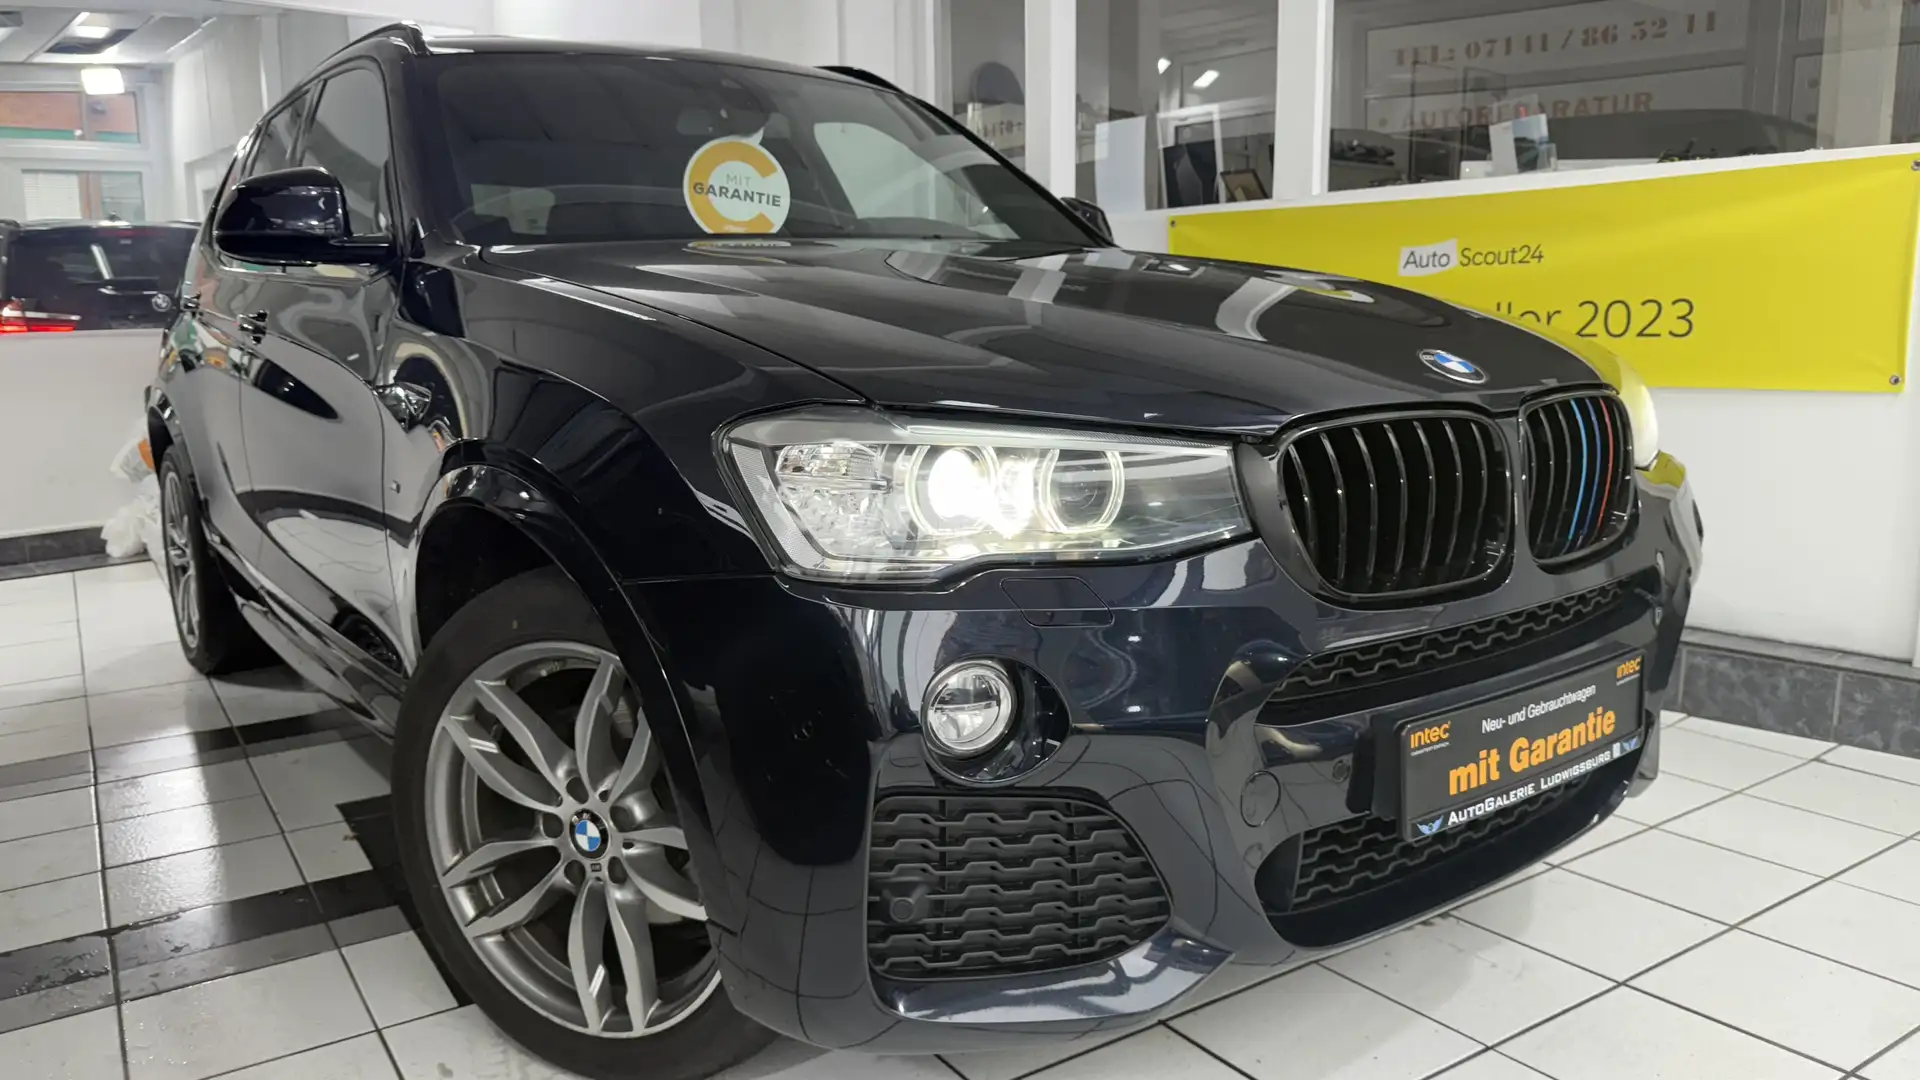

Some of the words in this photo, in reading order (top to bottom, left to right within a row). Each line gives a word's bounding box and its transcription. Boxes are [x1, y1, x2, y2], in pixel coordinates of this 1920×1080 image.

[1581, 24, 1618, 48] 86
[1631, 17, 1667, 41] 52
[725, 173, 752, 187] MIT
[693, 182, 781, 207] GARANTIE
[1403, 250, 1451, 269] Auto
[1459, 244, 1544, 267] Scout24
[1575, 298, 1695, 338] 2023
[1482, 718, 1506, 734] Neu-
[1508, 708, 1526, 726] und
[1527, 685, 1596, 719] Gebrauchtwagen
[1410, 723, 1451, 749] intec
[1450, 748, 1500, 795] mit
[1509, 706, 1616, 773] Garantie
